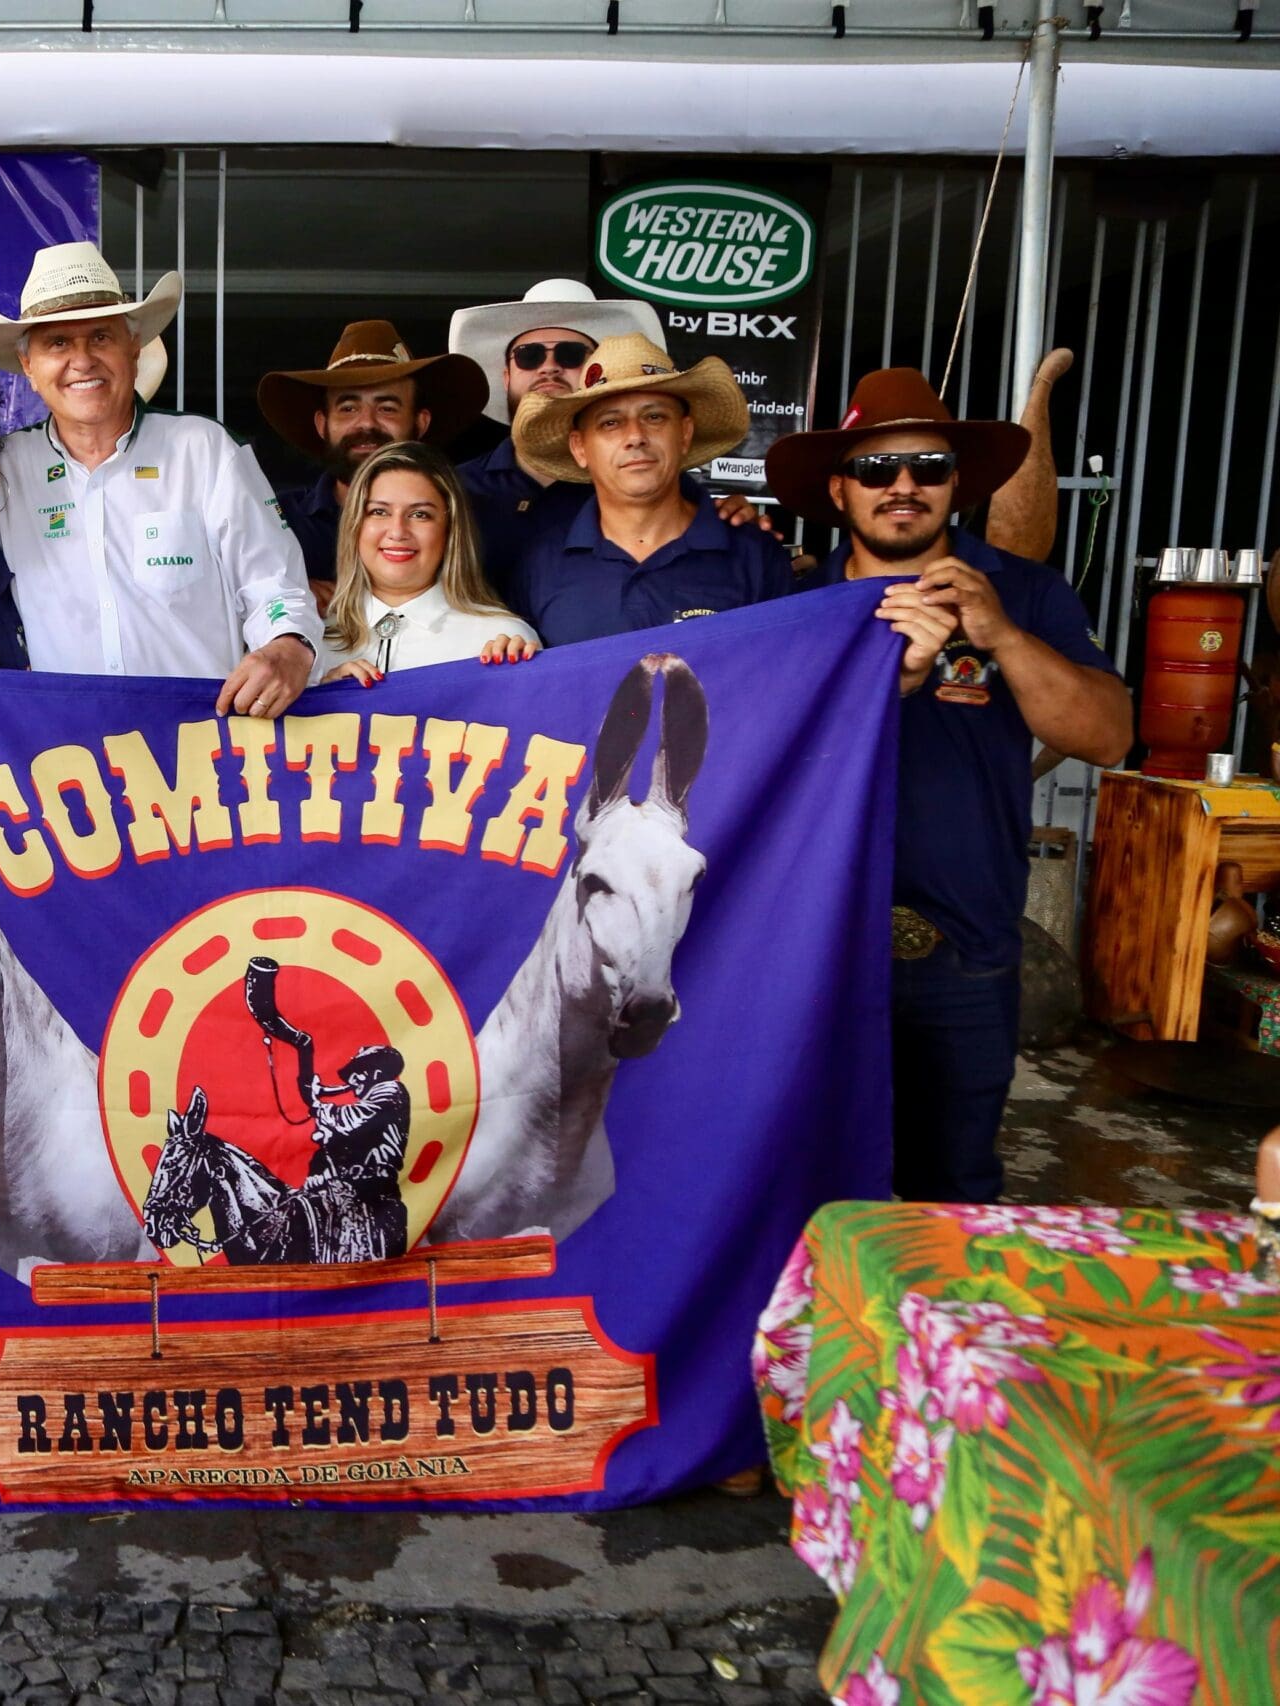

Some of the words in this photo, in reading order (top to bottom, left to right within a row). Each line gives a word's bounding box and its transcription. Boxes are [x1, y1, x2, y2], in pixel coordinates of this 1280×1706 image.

[624, 203, 779, 242] WESTERN
[635, 240, 788, 288] HOUSE
[668, 312, 703, 333] by
[707, 312, 797, 340] BKX
[747, 400, 804, 415] rindade
[717, 461, 764, 477] Wrangler
[147, 556, 193, 566] CAIADO
[17, 1387, 245, 1453] RANCHO
[264, 1378, 410, 1449] TEND
[429, 1366, 575, 1437] TUDO
[126, 1466, 294, 1486] APARECIDA
[300, 1464, 339, 1484] DE
